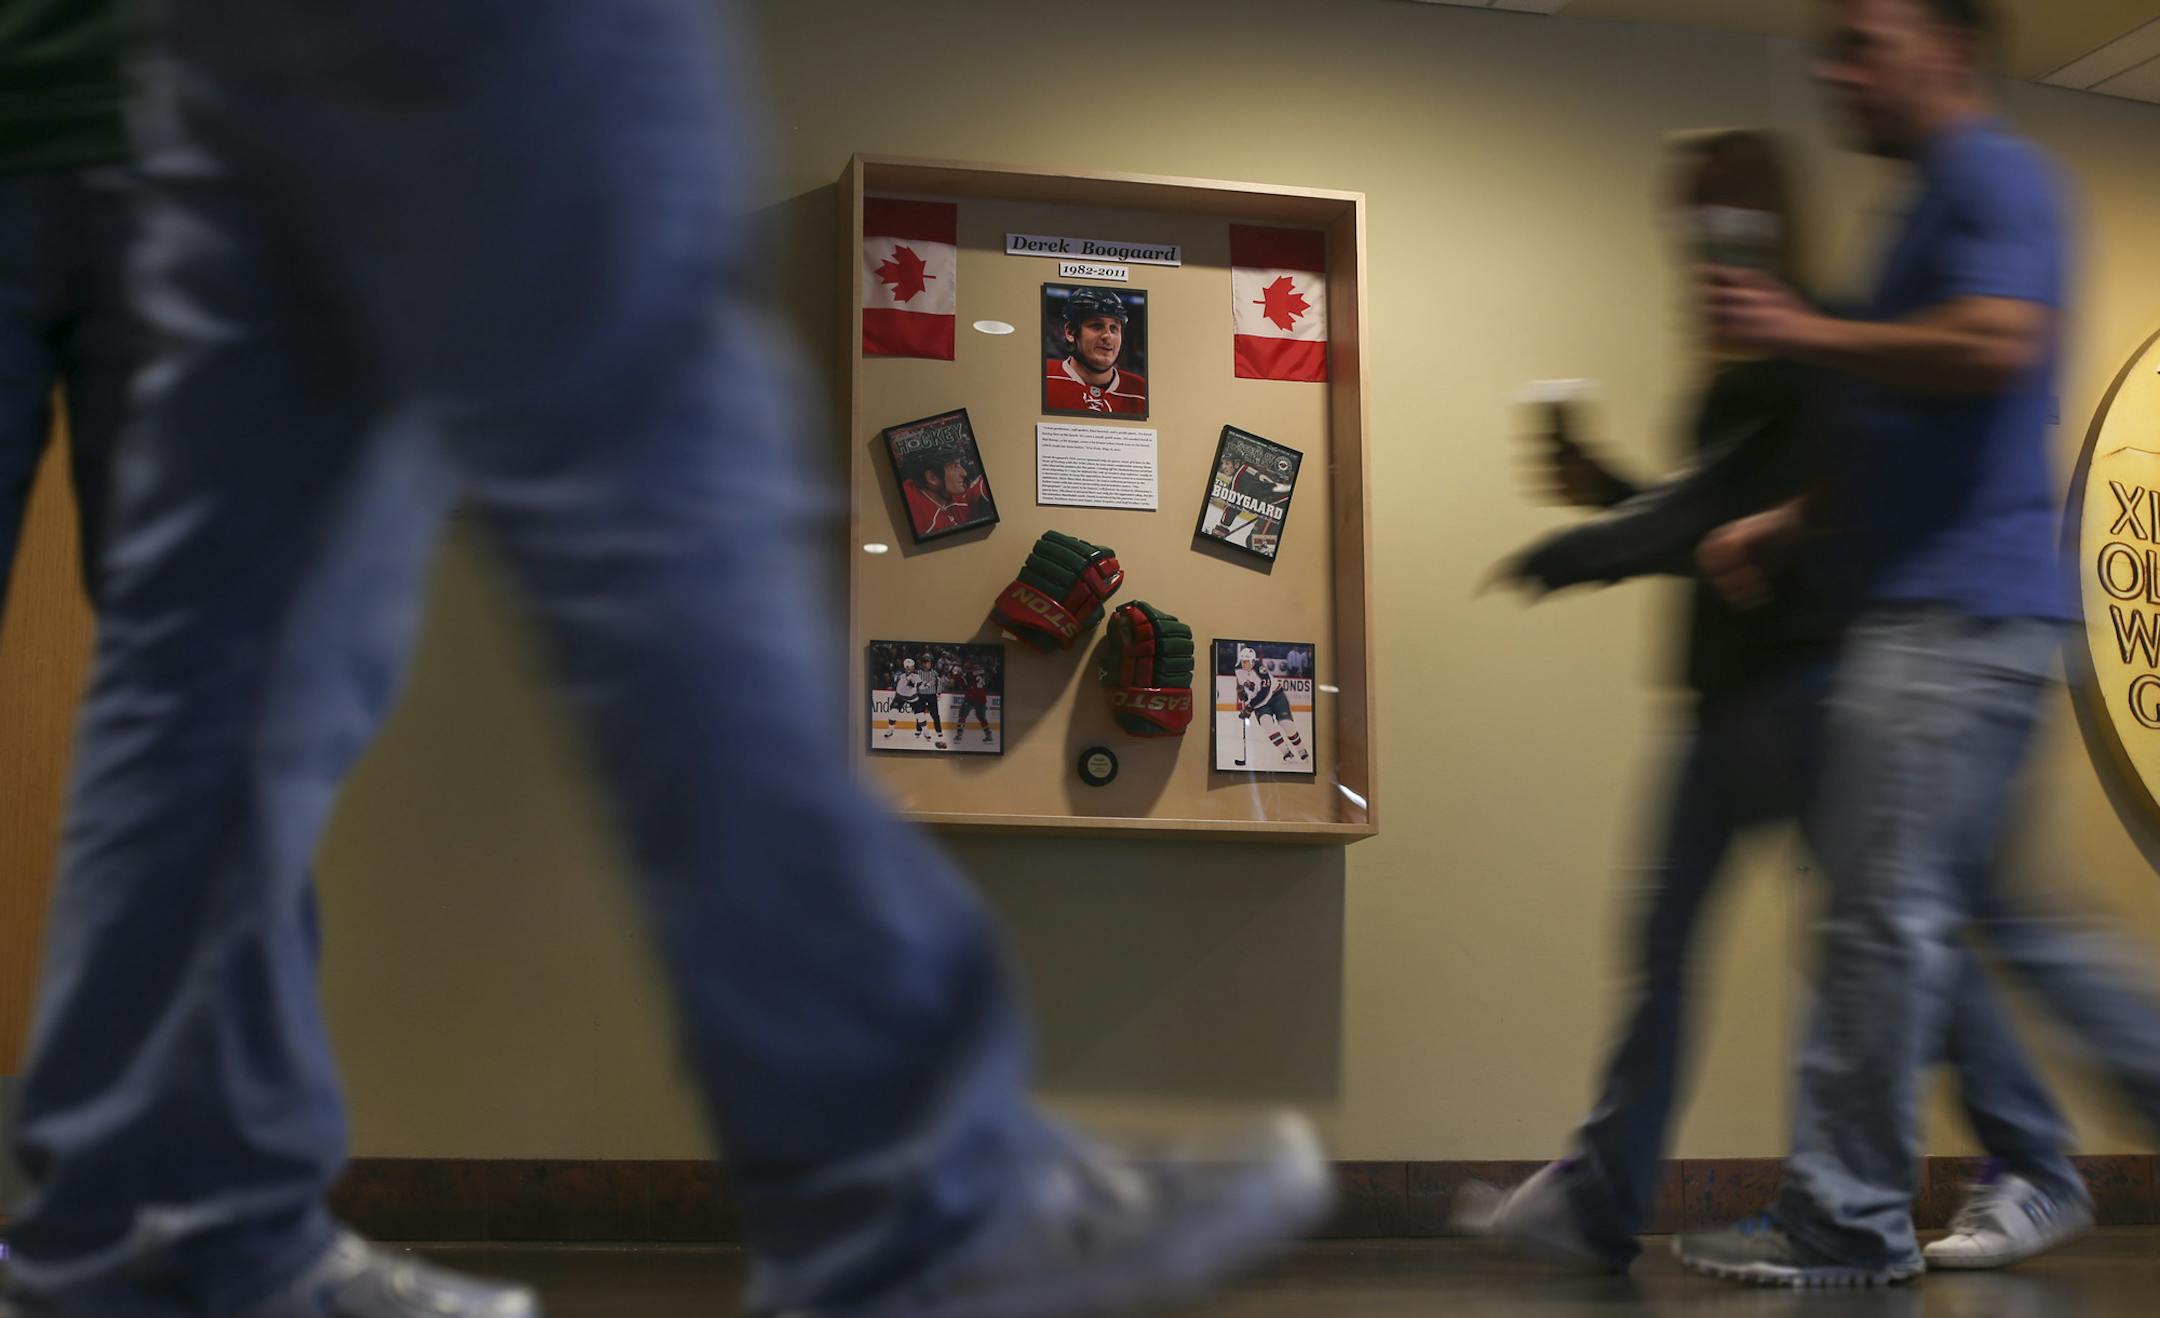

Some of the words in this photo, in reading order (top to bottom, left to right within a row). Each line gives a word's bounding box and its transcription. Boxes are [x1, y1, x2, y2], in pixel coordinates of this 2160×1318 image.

[1012, 235, 1070, 254] Derek
[1080, 241, 1177, 262] Boogaard
[1062, 264, 1127, 278] 1982-2011
[895, 422, 963, 454] HOCKEY
[1210, 484, 1284, 521] BODYGAARD
